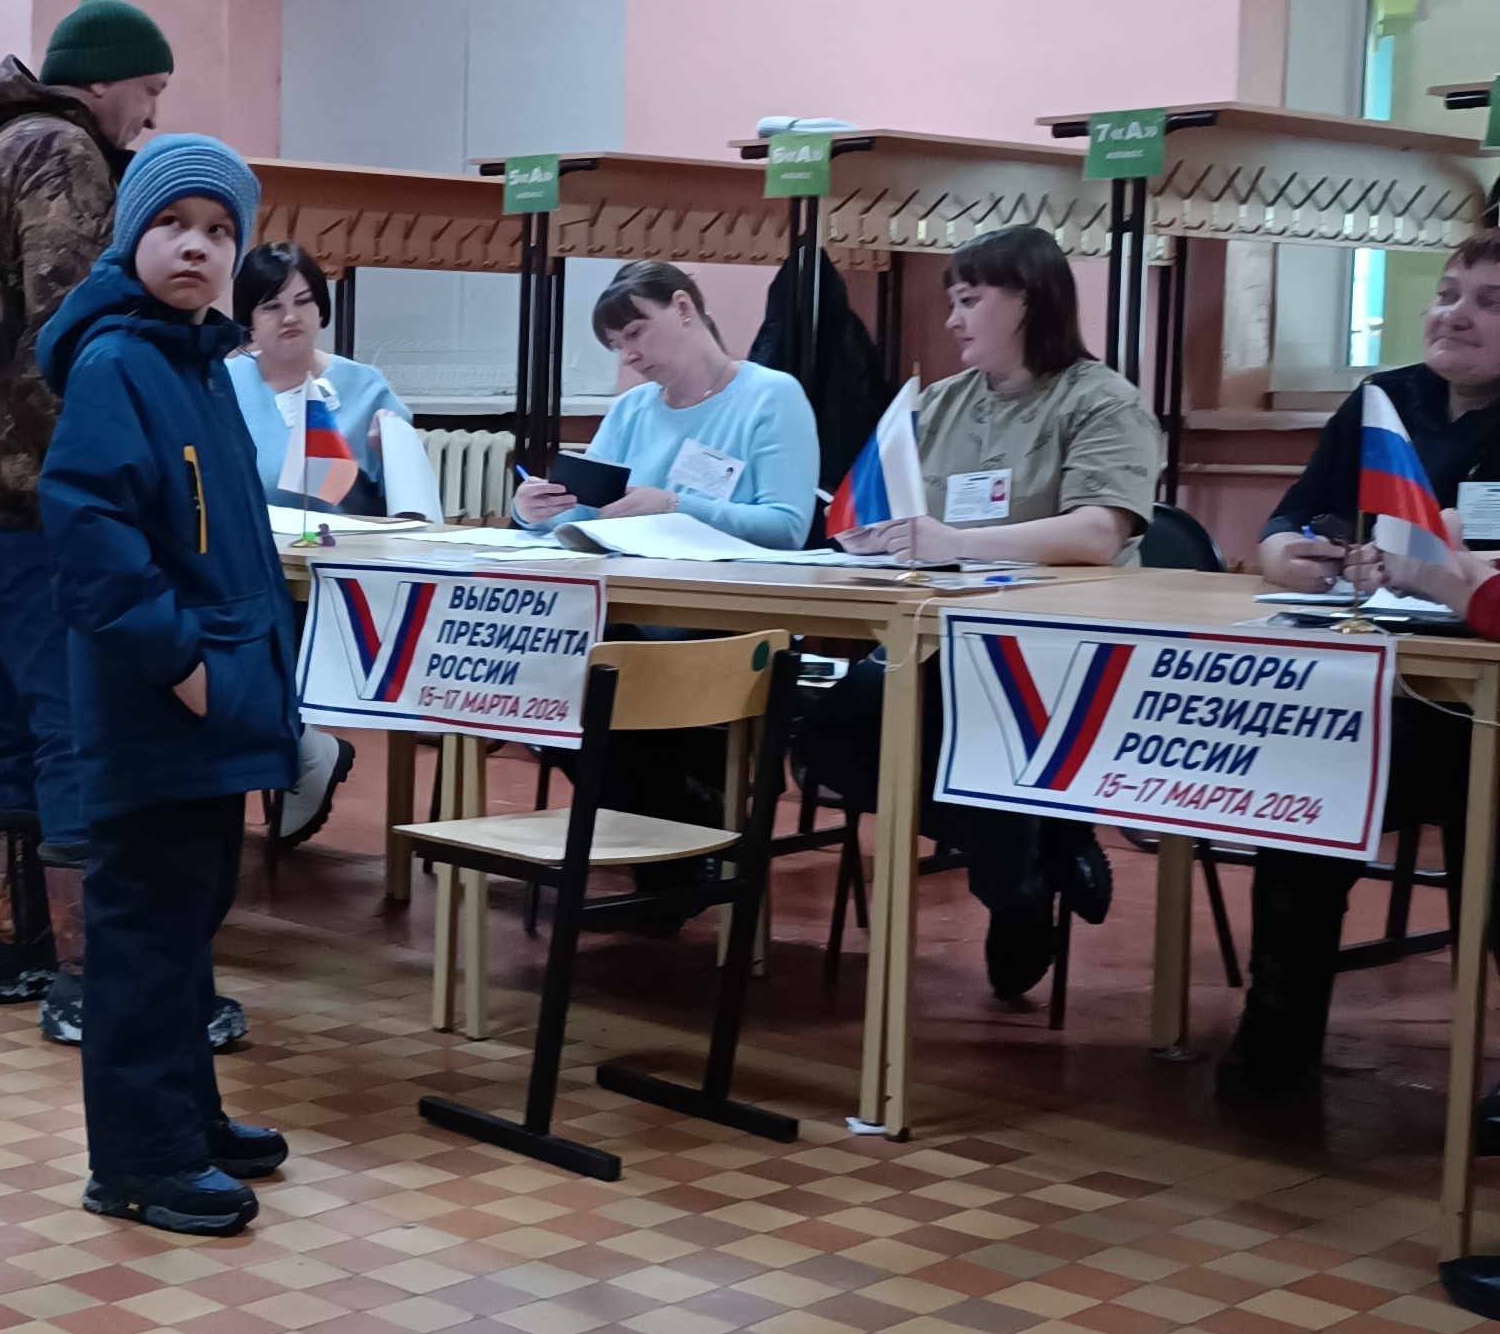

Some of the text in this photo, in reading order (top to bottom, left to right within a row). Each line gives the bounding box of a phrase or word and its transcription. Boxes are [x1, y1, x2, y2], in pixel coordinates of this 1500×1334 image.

[449, 585, 560, 617] ВЫБОРЫ
[436, 620, 589, 657] ПРЕЗИДЕНТА
[425, 653, 521, 685] РОССИИ
[1150, 648, 1320, 691] ВЫБОРЫ
[459, 691, 521, 717] МАРТА
[522, 697, 570, 722] 2024
[1132, 690, 1364, 742] ПРЕЗИДЕНТА
[1113, 732, 1262, 776] РОССИИ
[1161, 780, 1255, 816] МАРТА
[1252, 792, 1324, 825] 2024
